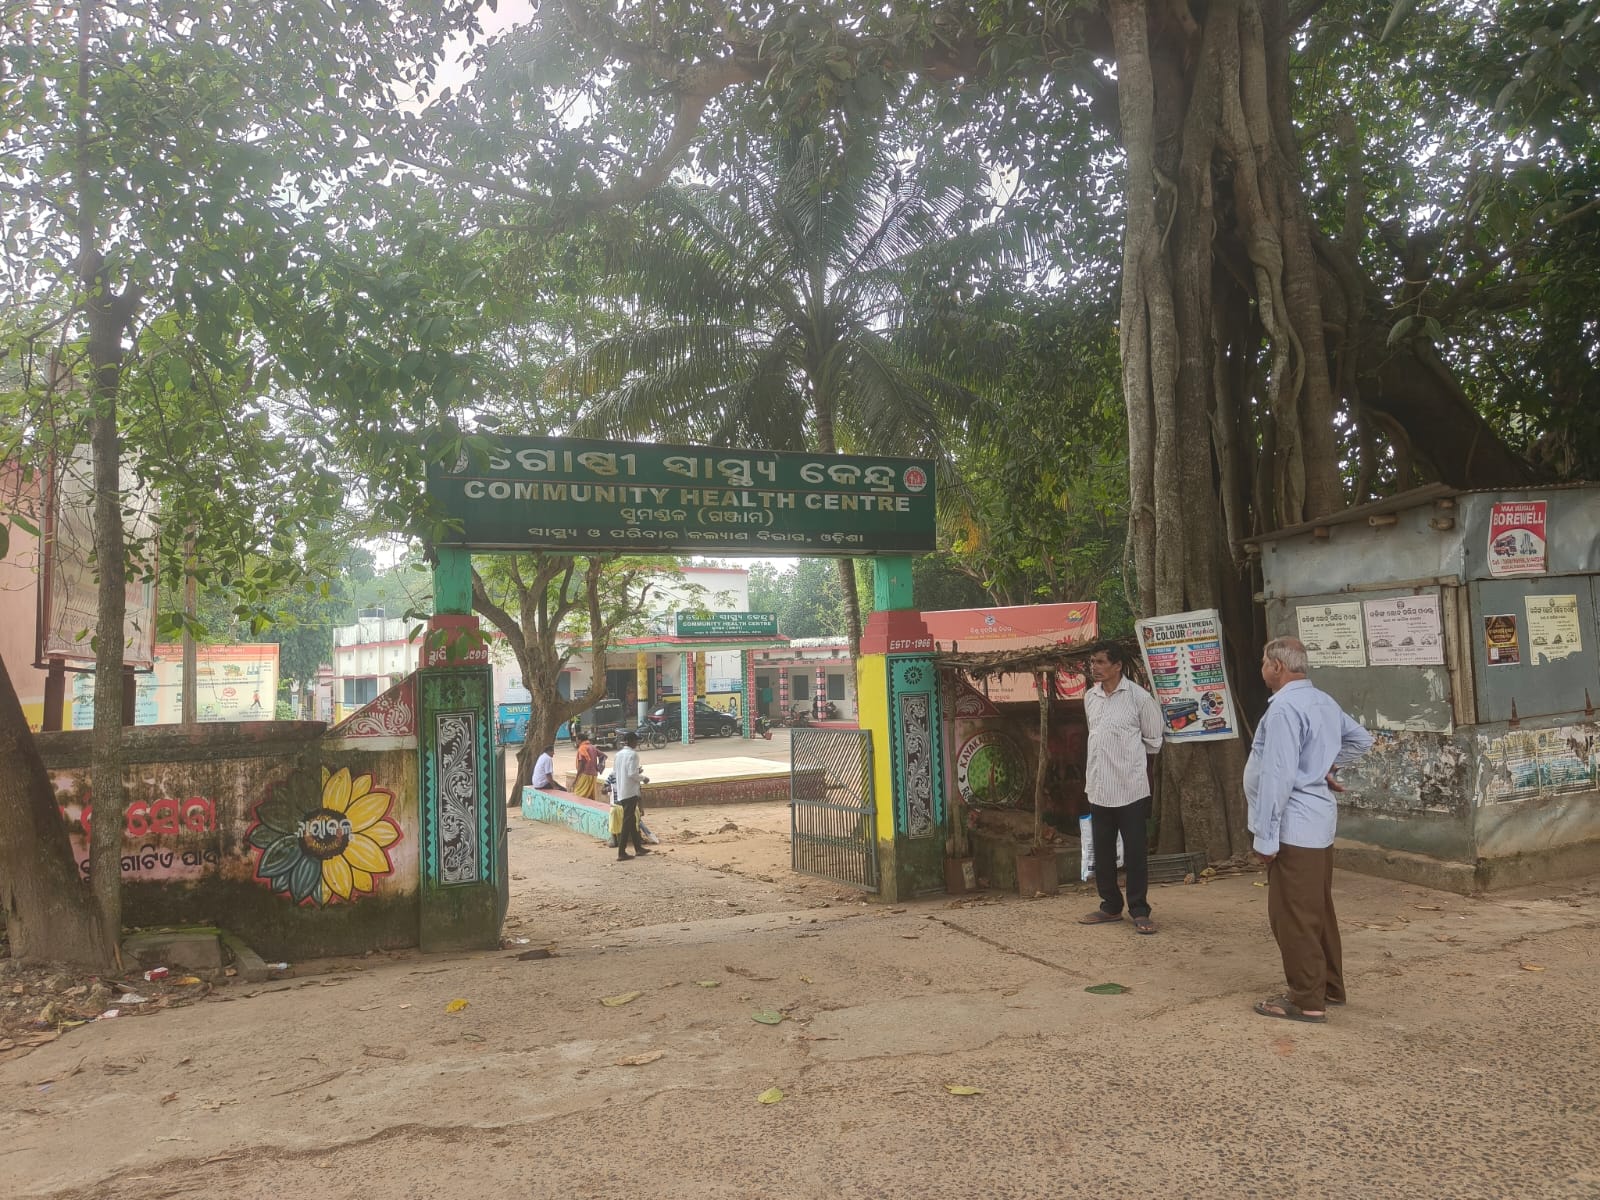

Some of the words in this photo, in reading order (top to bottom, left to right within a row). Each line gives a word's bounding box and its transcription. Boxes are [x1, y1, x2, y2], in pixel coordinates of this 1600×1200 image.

[464, 480, 669, 505] COMMUNITY
[680, 488, 795, 510] HEALTH
[805, 493, 911, 512] CENTRE
[1493, 511, 1544, 526] BOREWELL
[587, 528, 601, 538] ଓ
[1155, 629, 1186, 641] COLOUR
